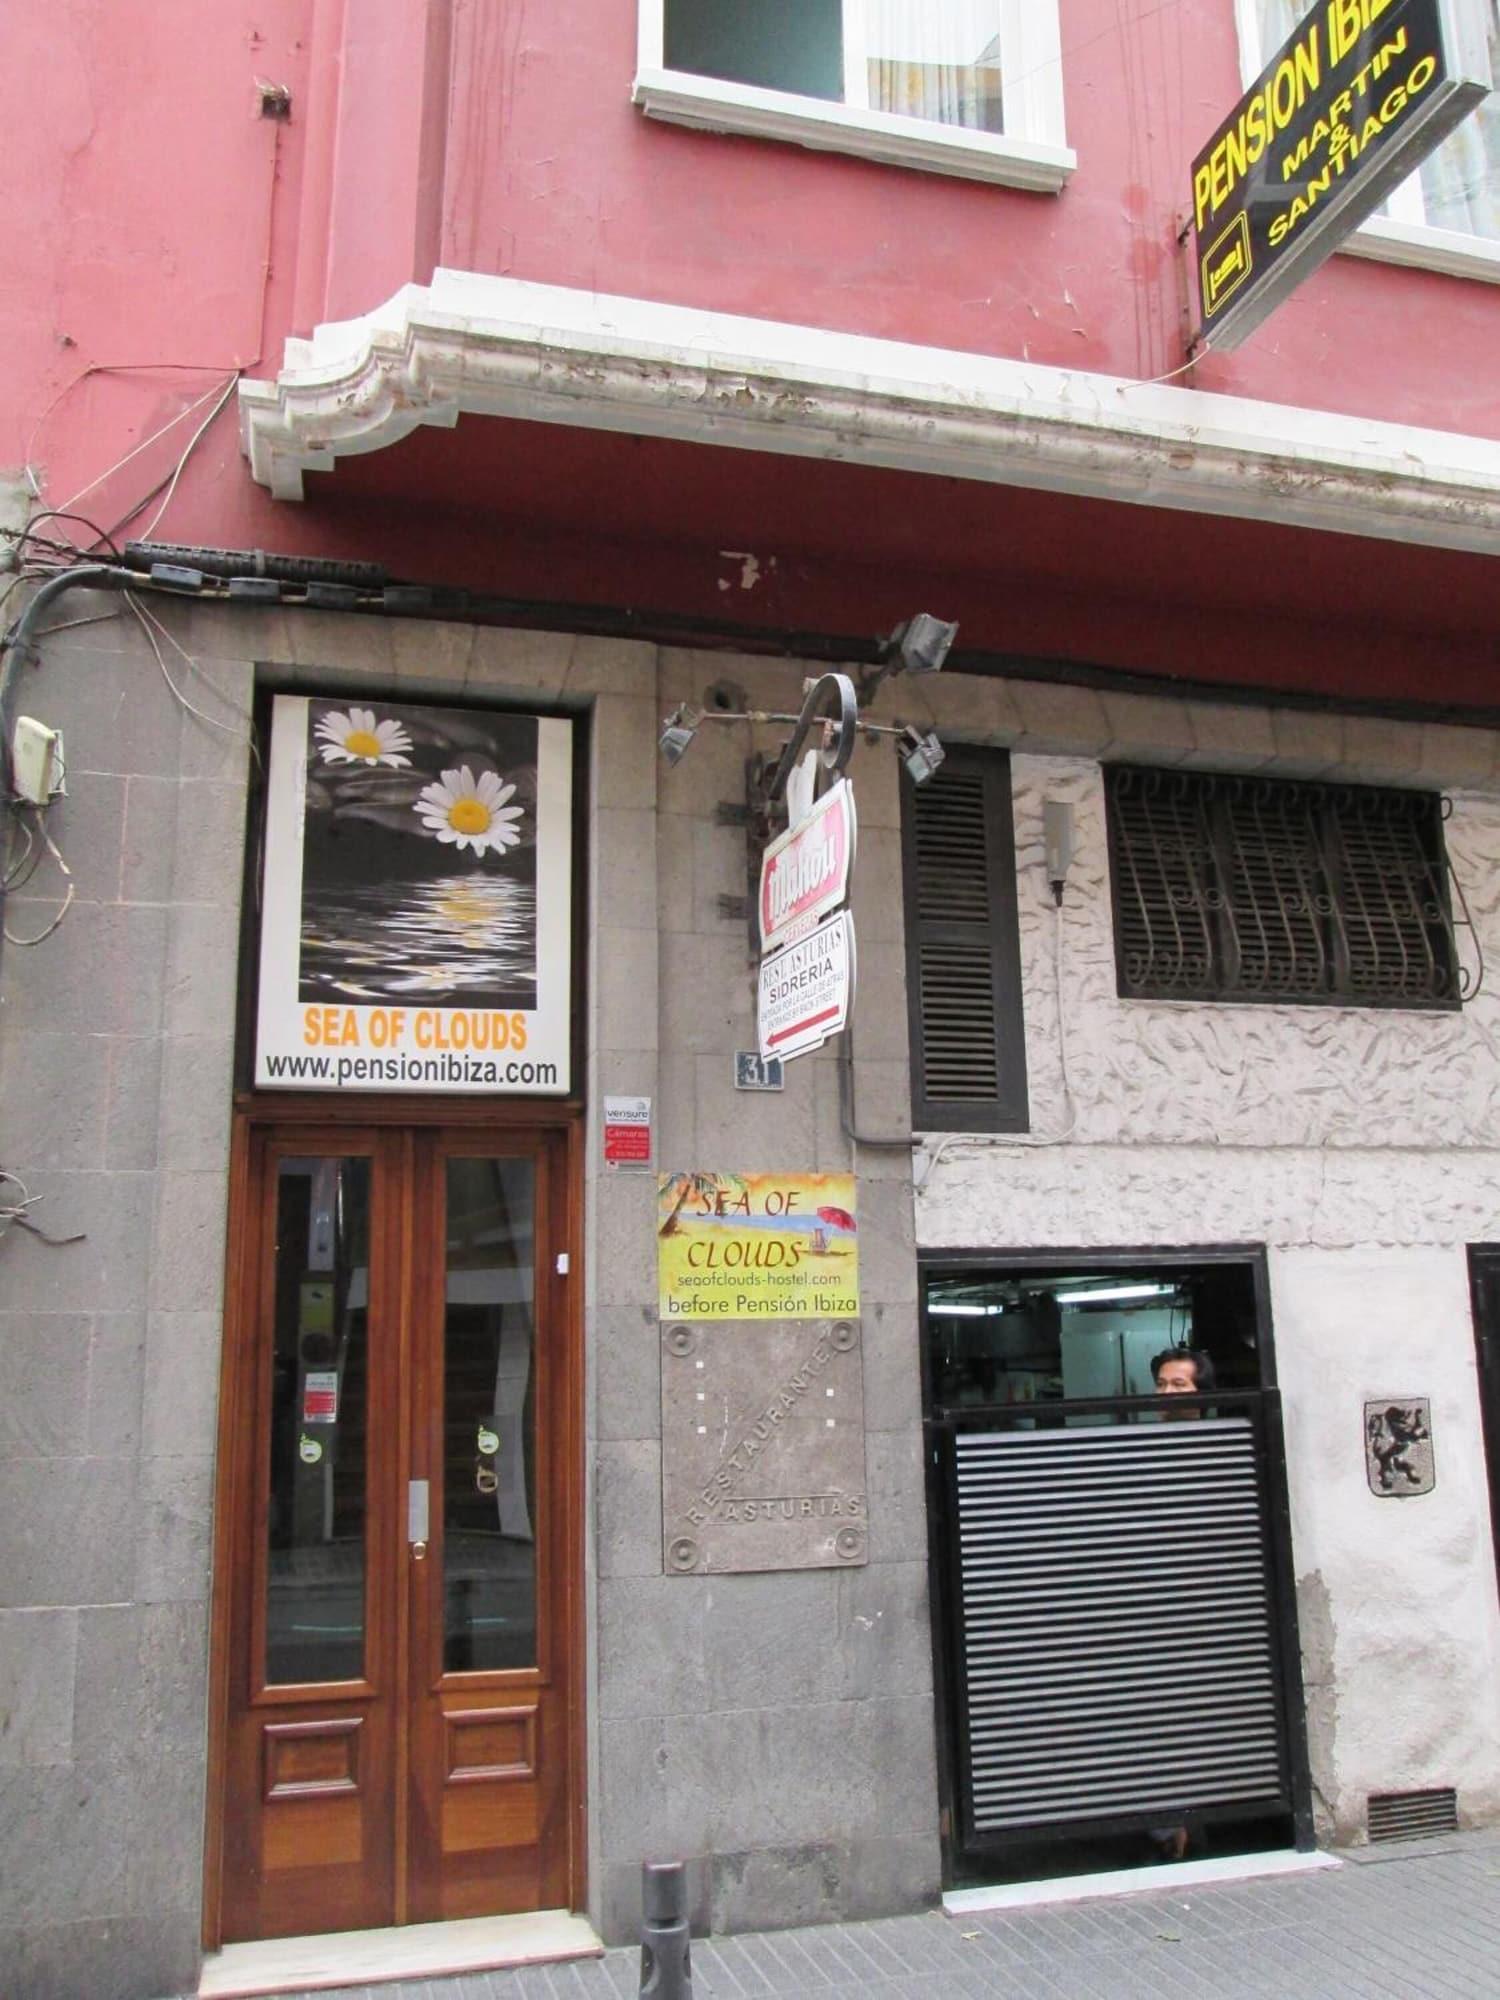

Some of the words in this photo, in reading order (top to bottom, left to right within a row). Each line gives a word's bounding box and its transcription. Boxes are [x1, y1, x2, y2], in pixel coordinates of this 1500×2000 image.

[1282, 26, 1407, 182] MARTIN
[1195, 24, 1322, 232] PENSION
[1329, 123, 1352, 156] &
[1268, 56, 1437, 247] SANTIAGO
[790, 924, 841, 972] ASTURIAS
[769, 957, 832, 1003] SIDRERIA
[304, 1007, 359, 1047] SEA
[368, 1010, 405, 1048] OF
[414, 1011, 527, 1050] CLOUDS
[266, 1053, 557, 1085] www.pensionibiza.com
[696, 1191, 750, 1218] SEA
[765, 1191, 800, 1217] OF
[687, 1241, 802, 1268] CLOUDS
[678, 1272, 842, 1287] seaofclouds-hostel.com
[668, 1296, 729, 1313] before
[736, 1294, 808, 1313] Pensión
[815, 1295, 857, 1312] Ibiza
[686, 1346, 830, 1527] RESTAURANTE
[726, 1498, 861, 1523] ASTURIAS
